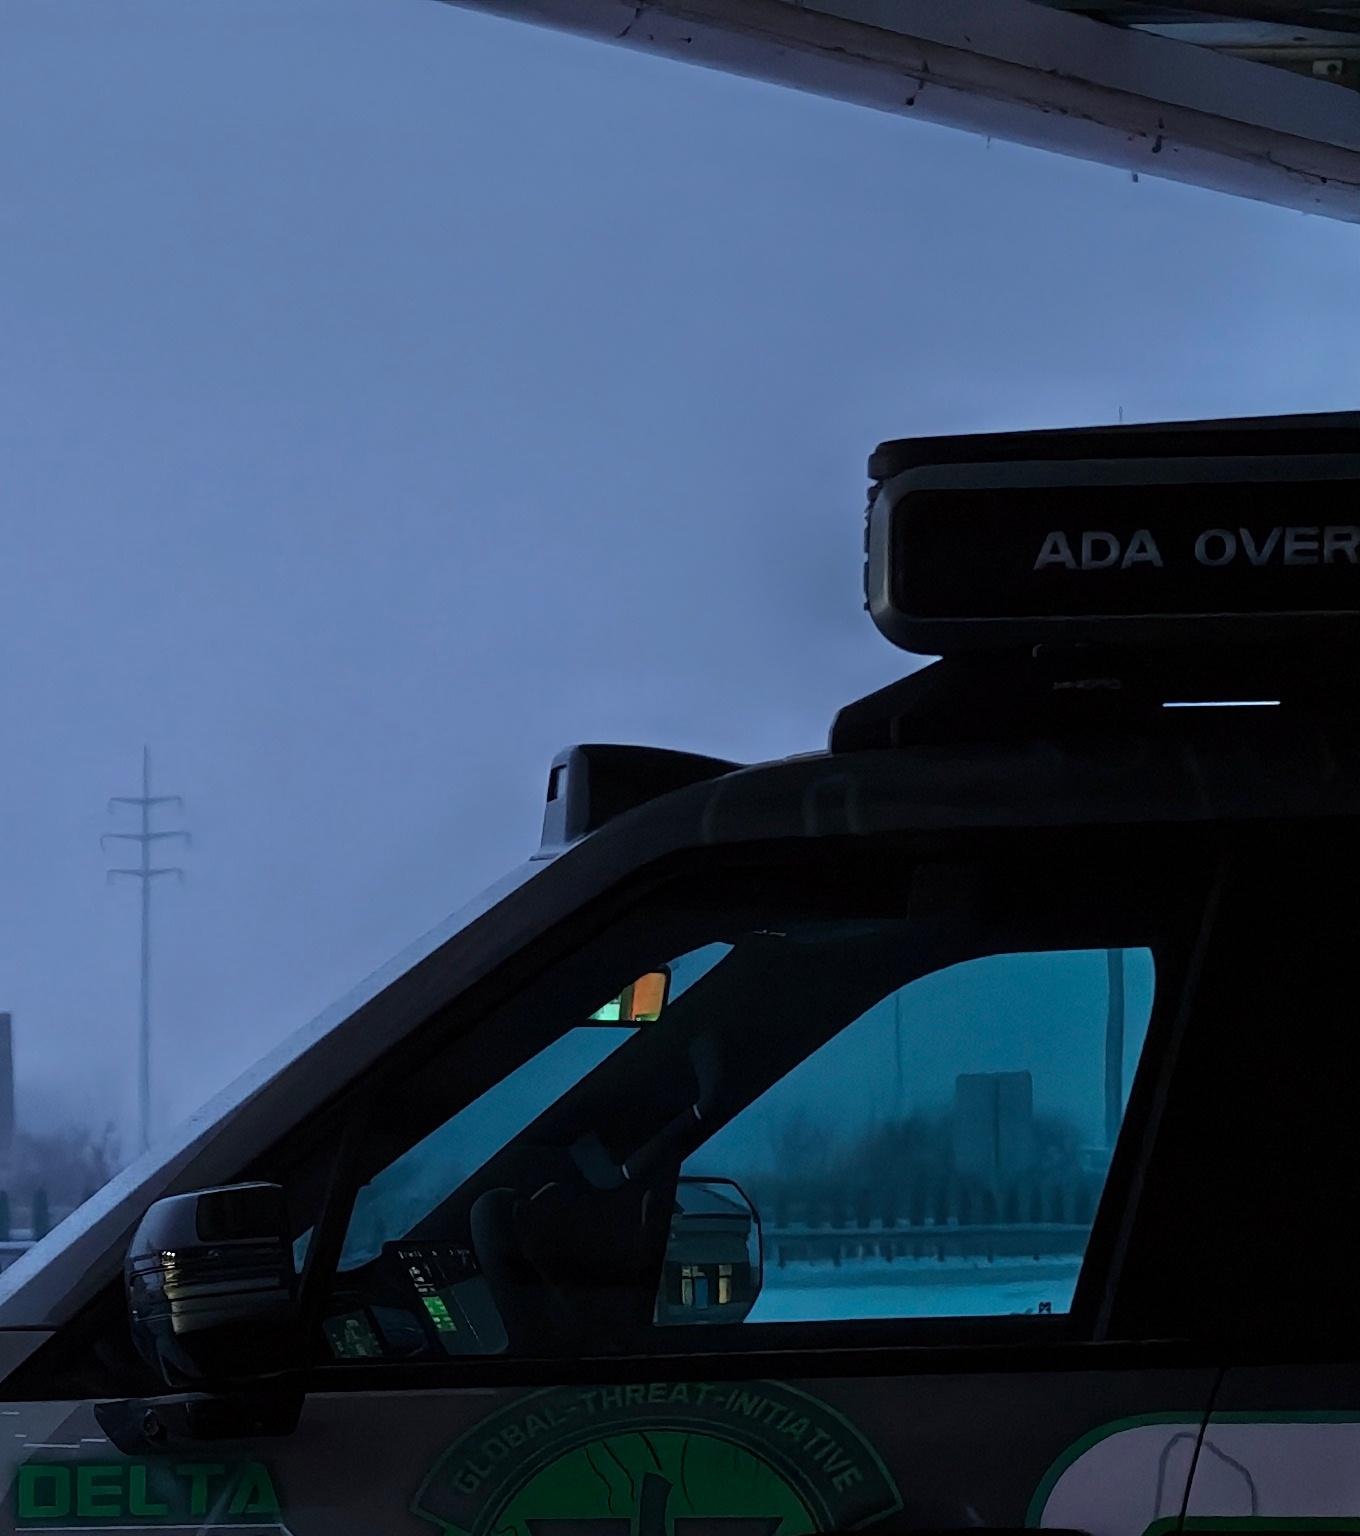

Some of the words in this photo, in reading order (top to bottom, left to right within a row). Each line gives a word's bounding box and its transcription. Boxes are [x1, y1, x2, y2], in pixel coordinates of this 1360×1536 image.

[1032, 529, 1164, 571] ADA
[1194, 525, 1360, 567] OVER
[16, 1461, 283, 1519] DELTA
